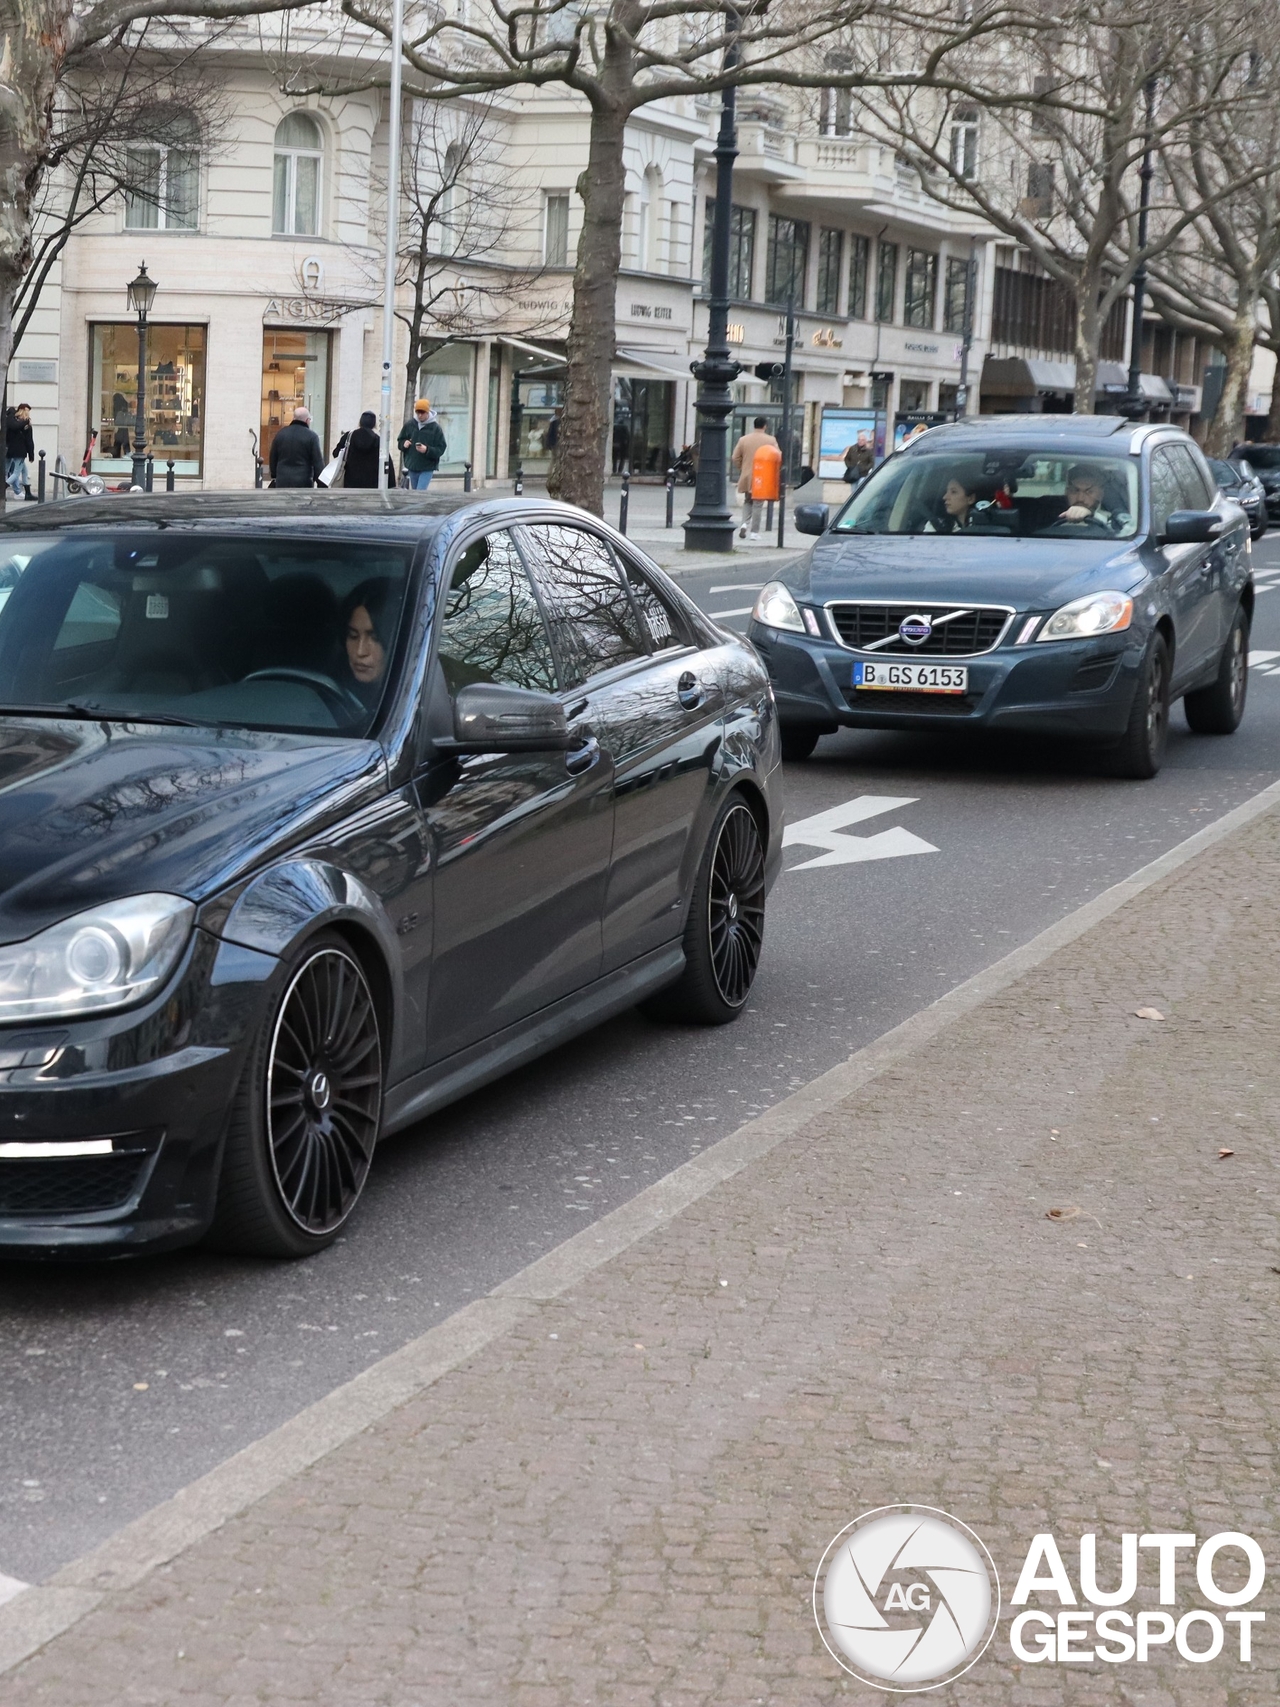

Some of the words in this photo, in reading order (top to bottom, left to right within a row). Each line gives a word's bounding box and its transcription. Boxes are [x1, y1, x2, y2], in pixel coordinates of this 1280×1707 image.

[864, 665, 876, 683] B
[888, 666, 912, 685] GS
[917, 668, 965, 687] 6153
